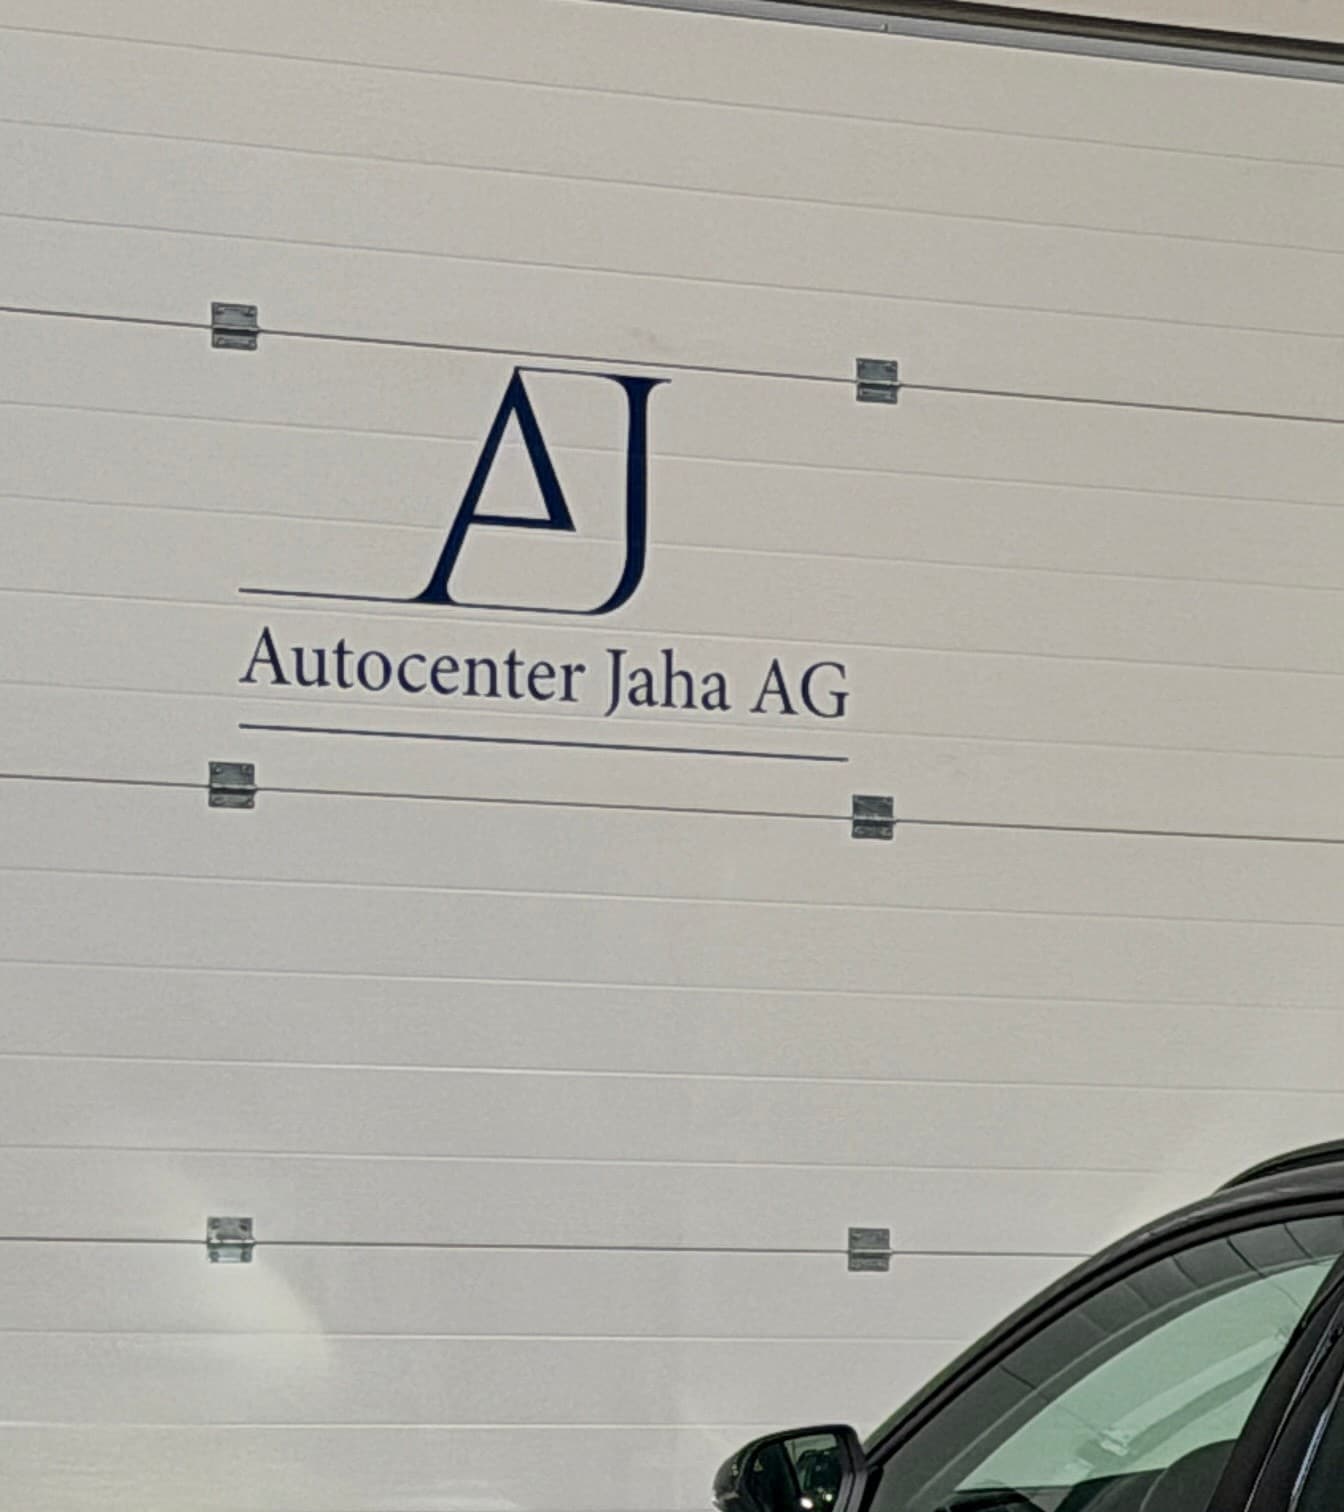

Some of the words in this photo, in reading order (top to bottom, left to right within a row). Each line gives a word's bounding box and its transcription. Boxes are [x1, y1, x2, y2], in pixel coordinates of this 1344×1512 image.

[409, 366, 672, 615] AJ
[238, 626, 587, 702] Autocenter
[603, 648, 732, 718] Jaha
[749, 657, 850, 718] AG
